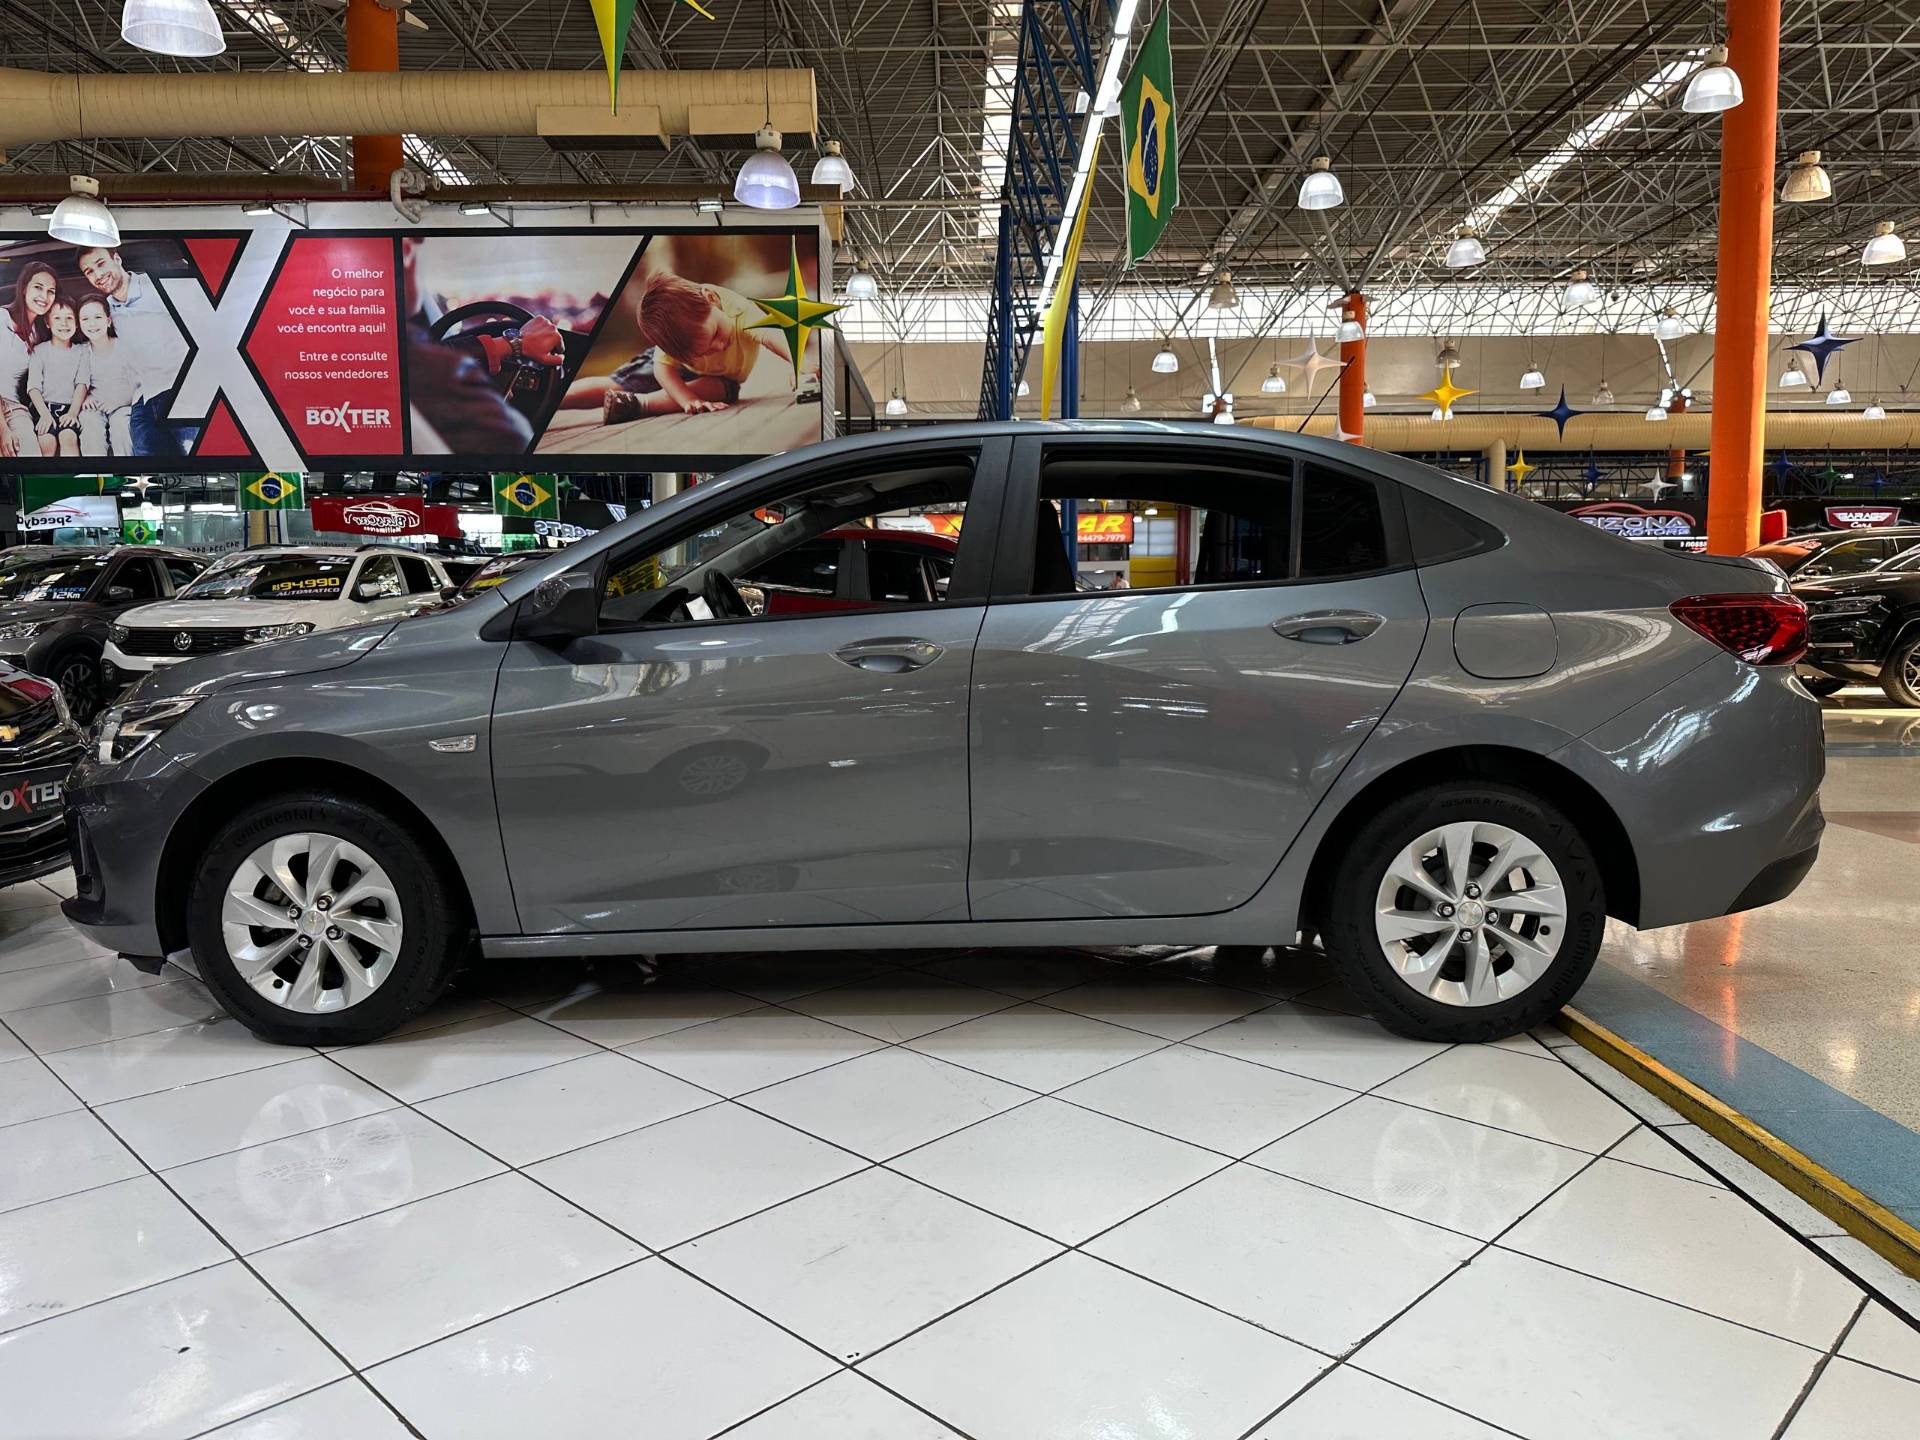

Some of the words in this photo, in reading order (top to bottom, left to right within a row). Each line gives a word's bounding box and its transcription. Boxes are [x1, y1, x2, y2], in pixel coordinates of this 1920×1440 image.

[331, 268, 342, 279] O
[344, 268, 384, 279] melhor
[313, 286, 358, 299] negócio
[361, 288, 385, 299] para
[288, 304, 315, 315] você
[318, 307, 325, 315] e
[327, 306, 347, 315] sua
[349, 304, 386, 315] família
[277, 322, 304, 333] você
[307, 323, 357, 333] encontra
[359, 322, 386, 334] aqui!
[299, 351, 328, 361] Entre
[331, 353, 338, 361] e
[340, 351, 388, 361] consulte
[284, 371, 322, 380] nossos
[324, 369, 389, 379] vendedores
[305, 401, 391, 433] BOXTER
[1078, 515, 1126, 533] AR
[276, 587, 341, 597] AUTOMATICO
[0, 779, 64, 814] OXTER
